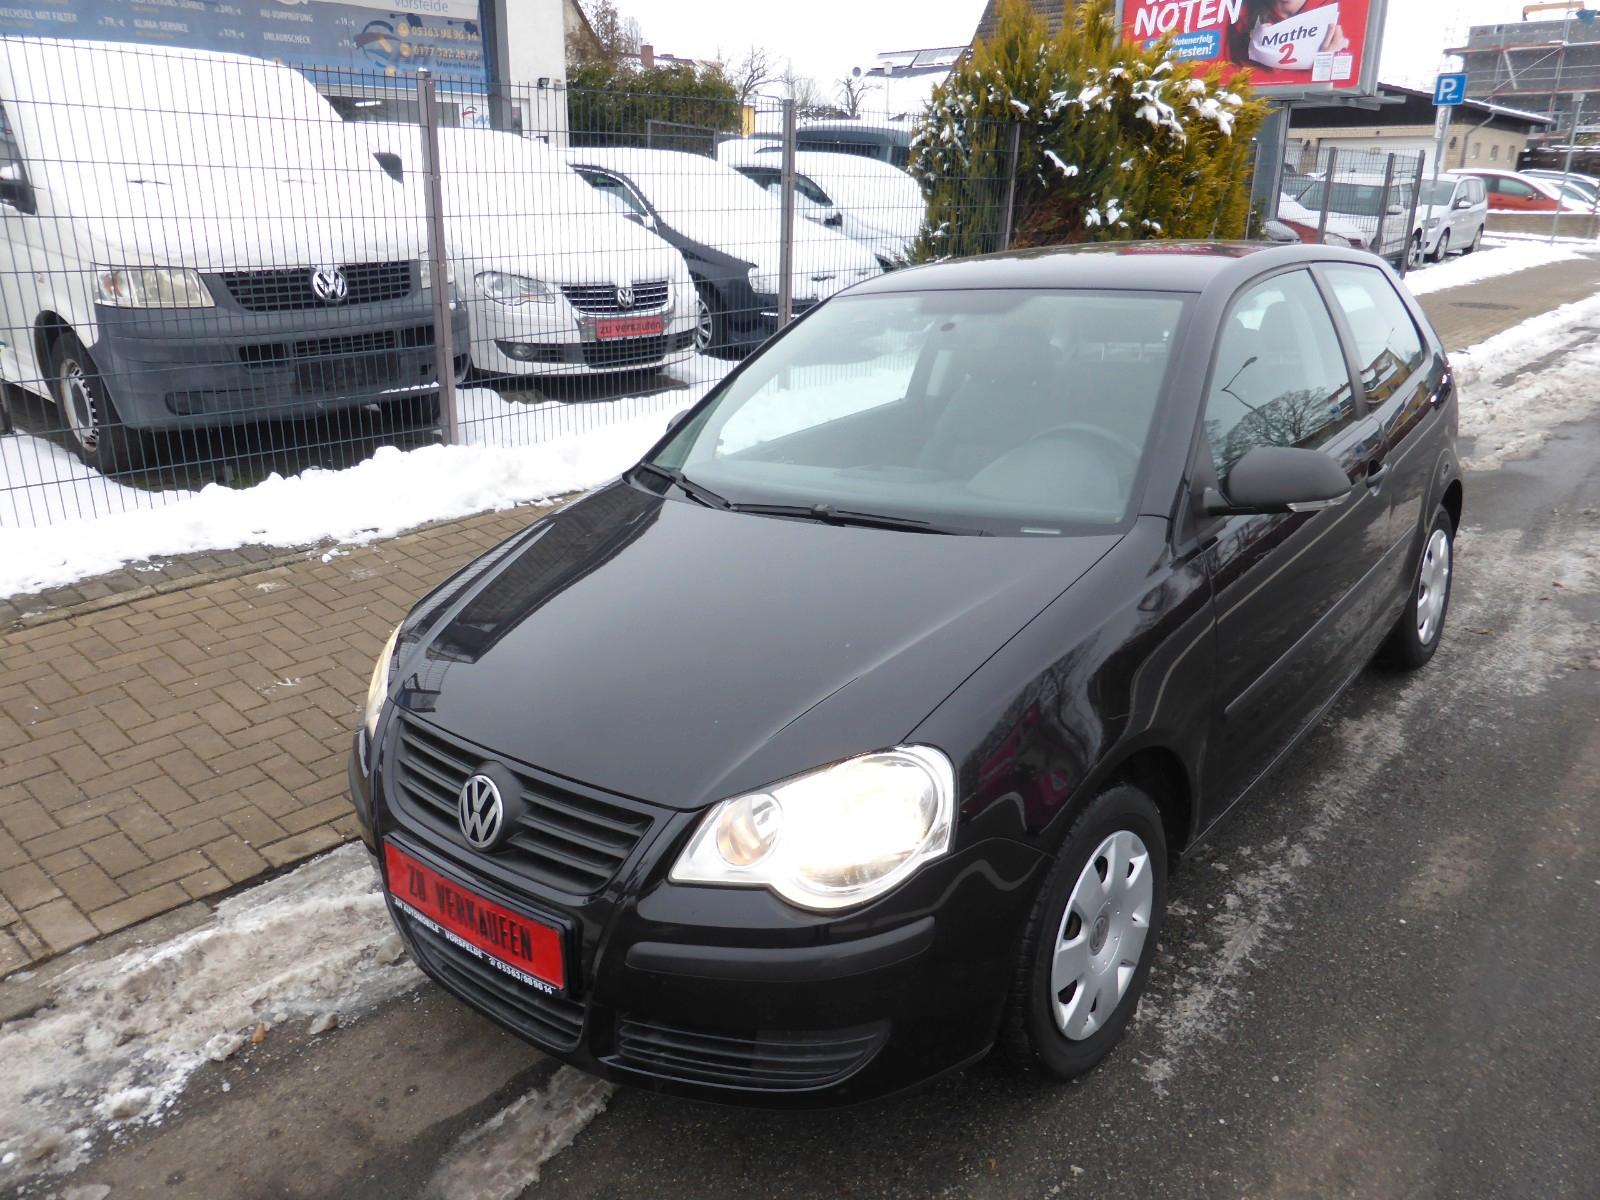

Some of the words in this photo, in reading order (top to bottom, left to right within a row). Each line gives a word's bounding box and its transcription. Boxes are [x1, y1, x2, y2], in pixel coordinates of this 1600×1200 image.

[1133, 0, 1242, 36] NOTEN
[1262, 26, 1318, 46] Mathe
[1278, 43, 1297, 65] 2
[1438, 78, 1457, 101] P
[458, 775, 503, 849] VW
[407, 863, 426, 903] ZU
[435, 881, 533, 963] VERKAUFEN
[445, 930, 483, 960] VORSFELDE
